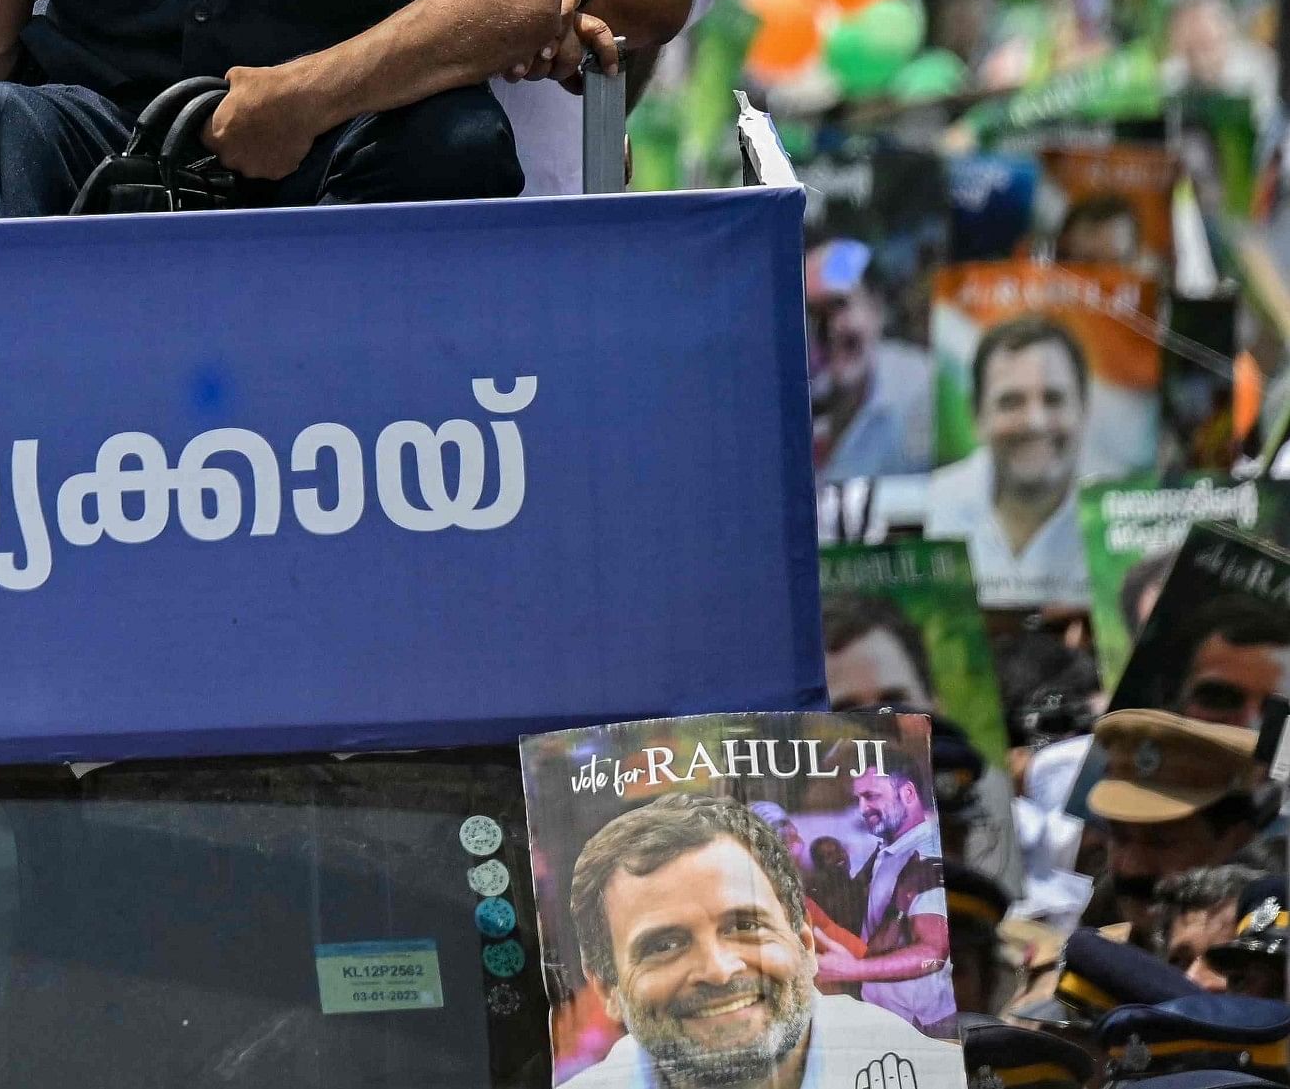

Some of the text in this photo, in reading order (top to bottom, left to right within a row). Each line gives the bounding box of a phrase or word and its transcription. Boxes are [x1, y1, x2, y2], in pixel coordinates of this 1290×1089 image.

[571, 739, 890, 797] vote for RAHUL JI
